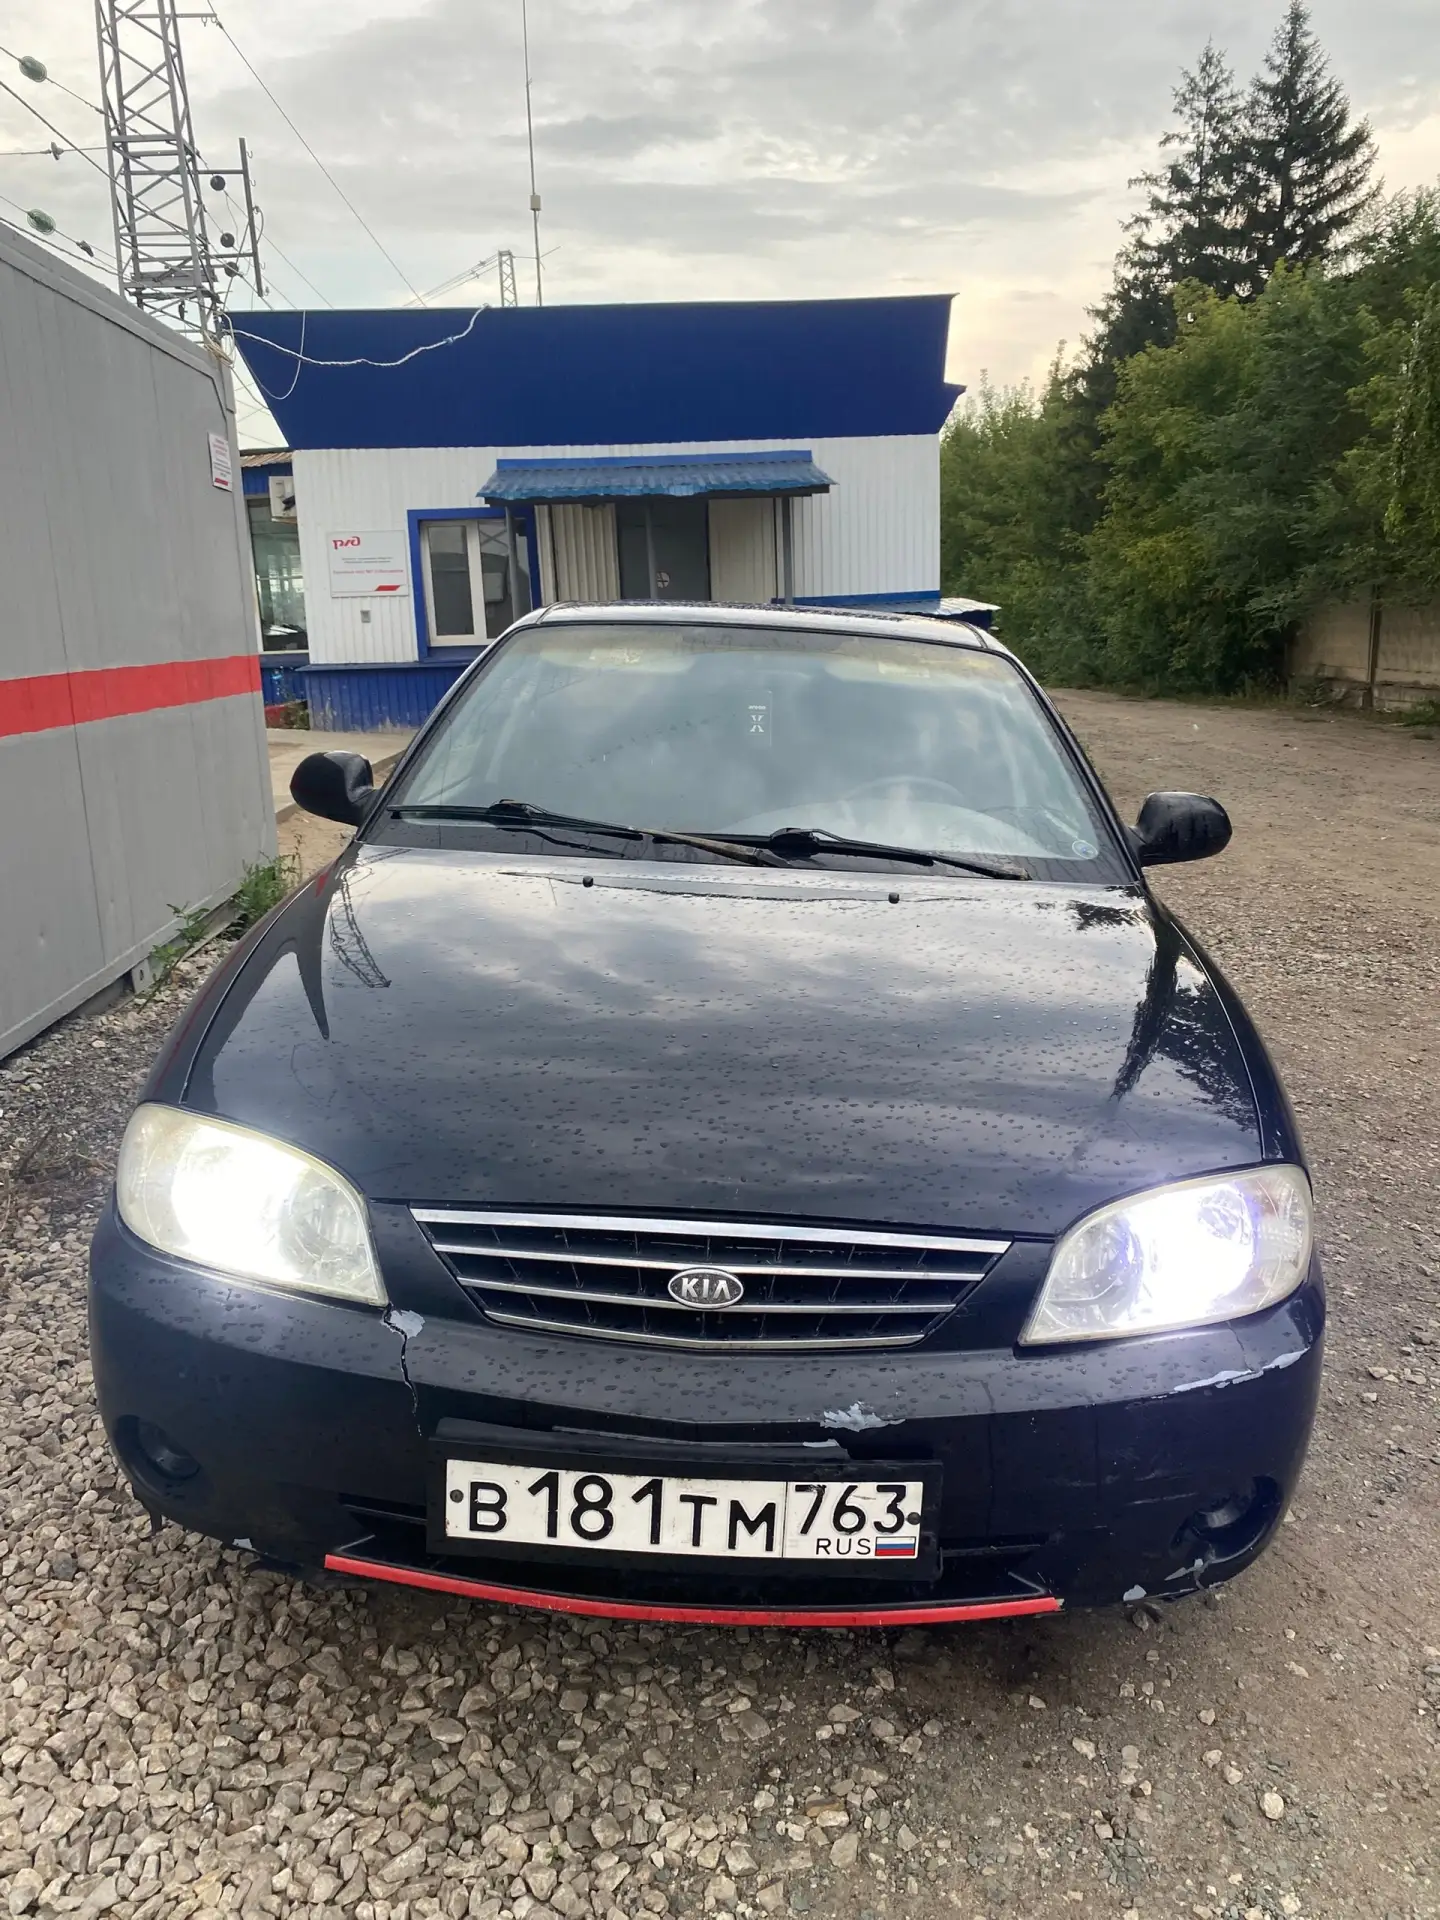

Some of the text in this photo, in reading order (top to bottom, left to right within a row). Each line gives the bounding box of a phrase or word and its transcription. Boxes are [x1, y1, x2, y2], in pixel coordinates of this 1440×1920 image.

[681, 1277, 732, 1300] KIA
[794, 1484, 907, 1535] 763
[816, 1538, 871, 1555] RUS
